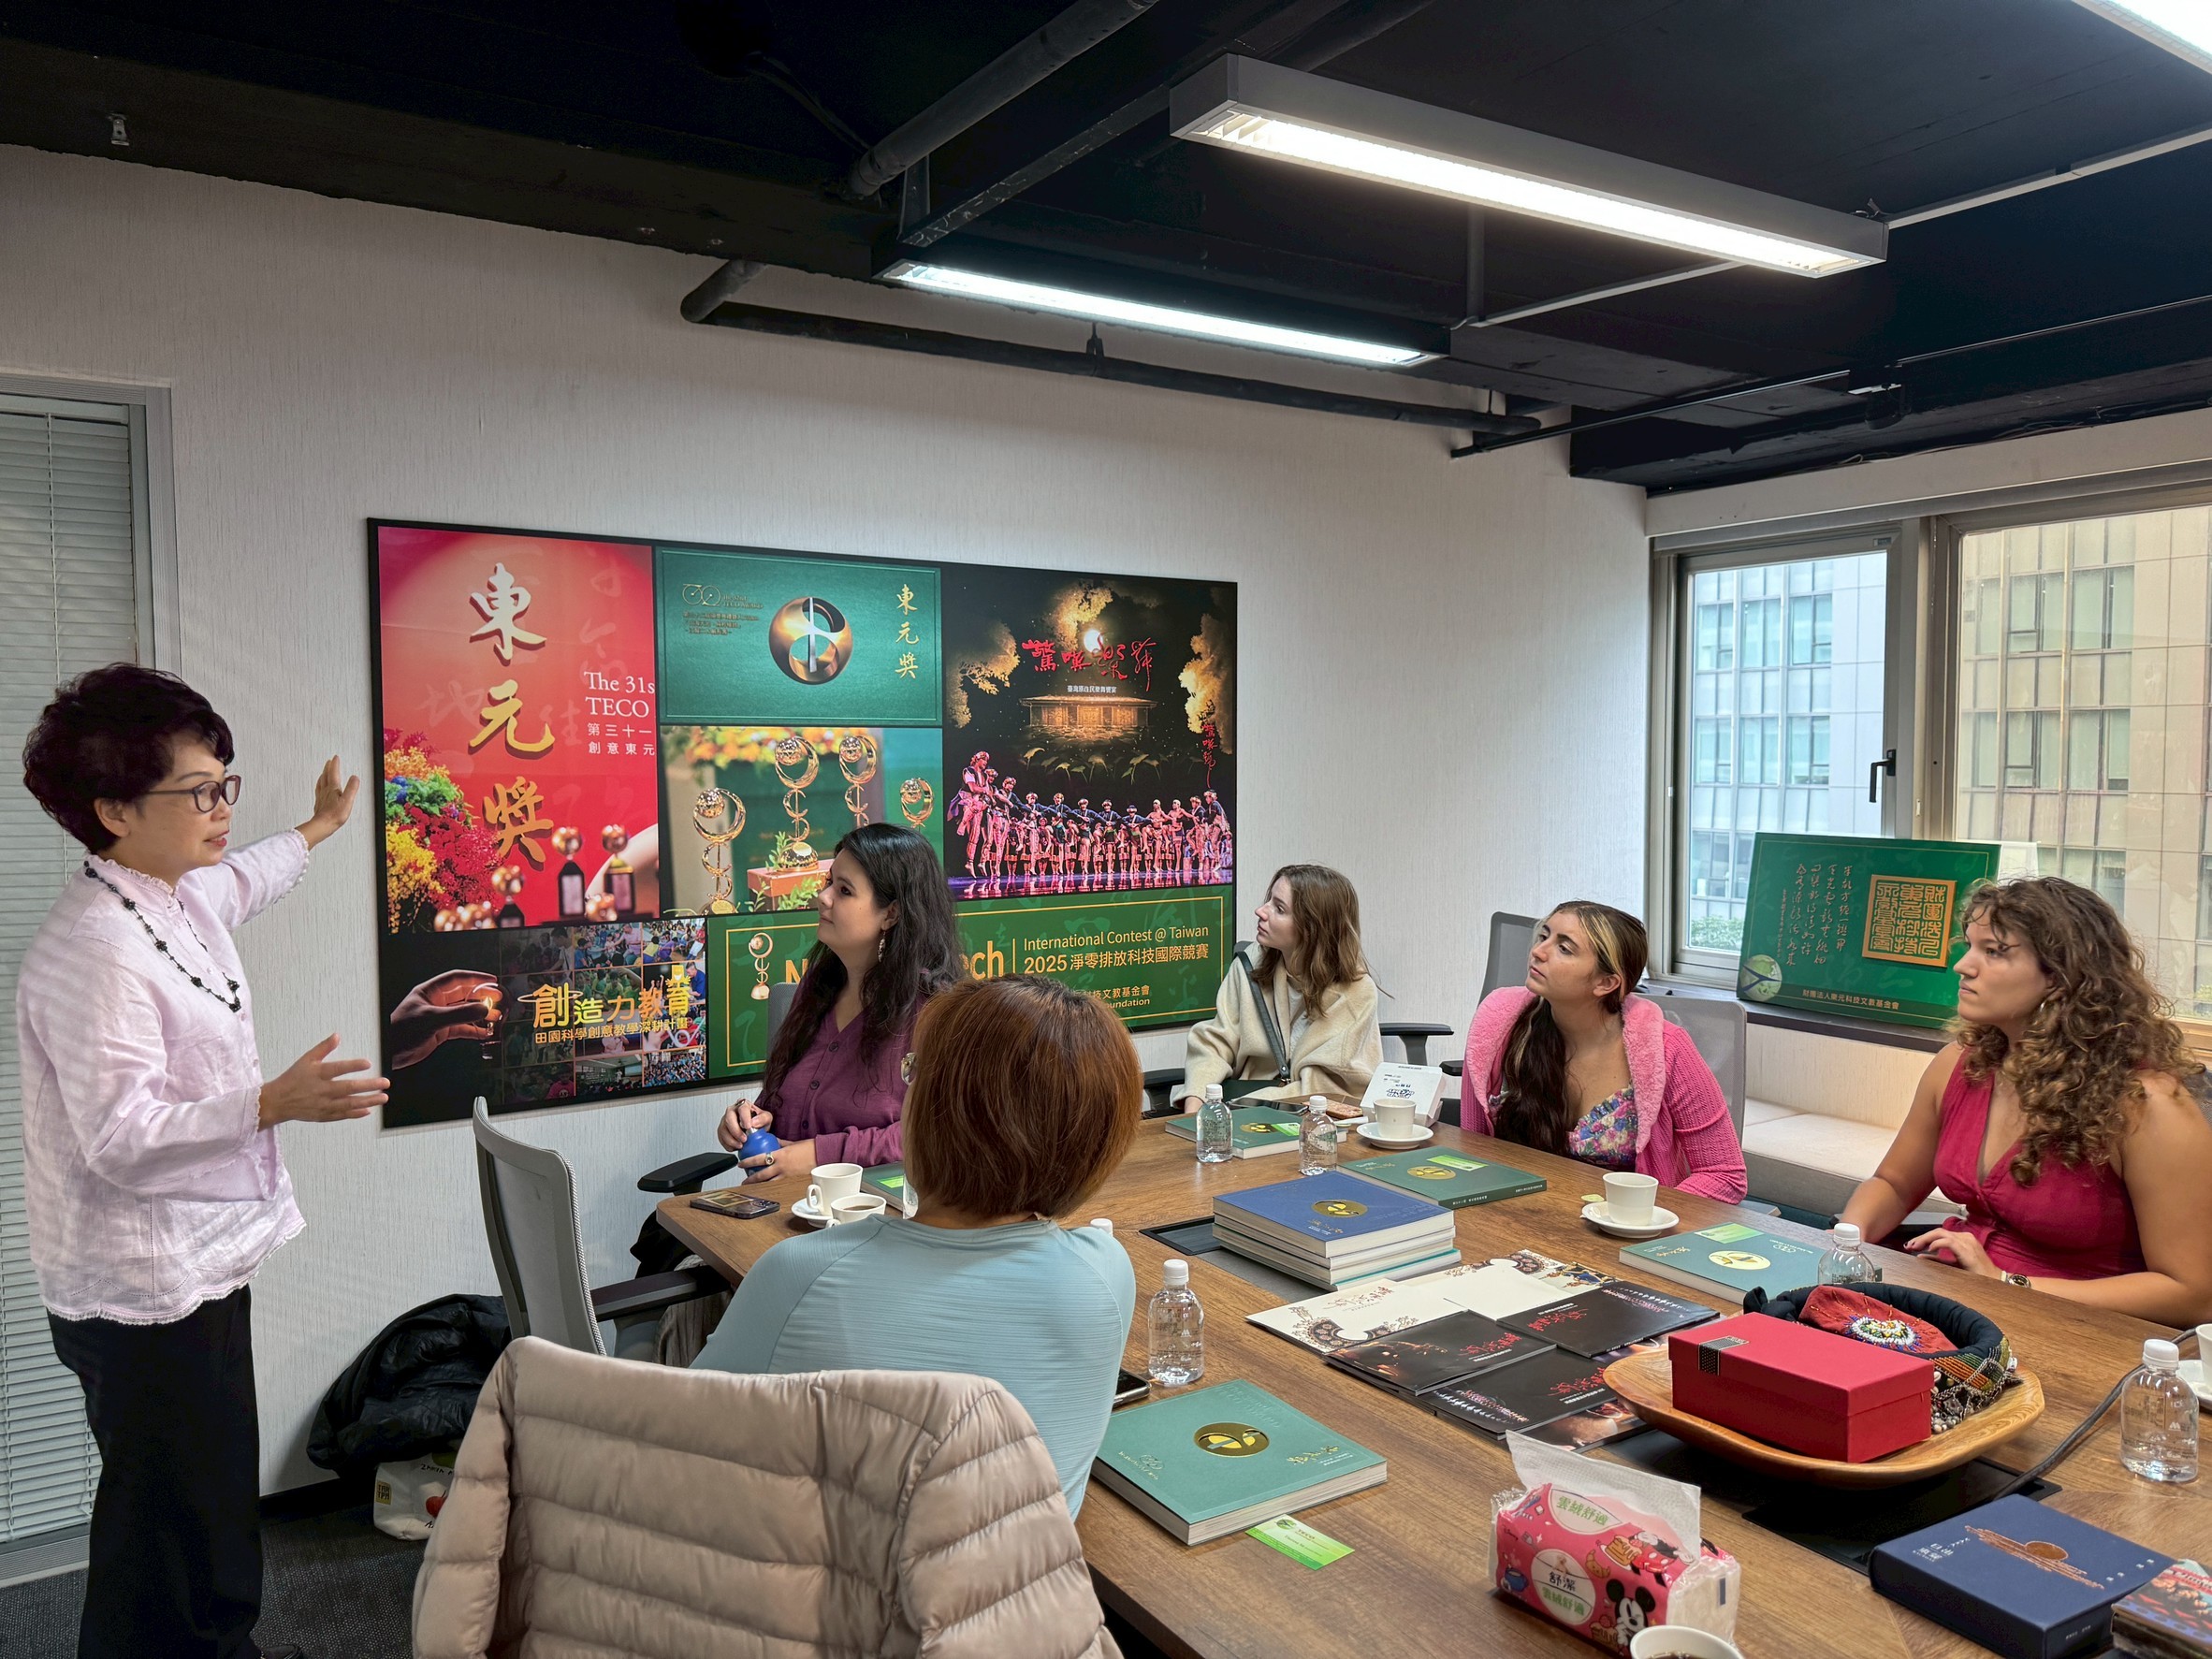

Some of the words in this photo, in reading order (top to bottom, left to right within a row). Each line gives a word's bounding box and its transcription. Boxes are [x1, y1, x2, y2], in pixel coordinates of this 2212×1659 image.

[895, 584, 920, 679] 東元獎
[584, 672, 619, 691] The
[625, 676, 655, 693] 31s
[469, 562, 555, 866] 東元獎
[585, 697, 649, 718] TECO
[588, 722, 652, 738] 第三十一
[589, 741, 655, 756] 創意東元
[1024, 930, 1104, 951] International
[1107, 928, 1152, 944] Contest
[1155, 927, 1167, 942] @
[1169, 925, 1209, 939] Taiwan
[1024, 954, 1068, 974] 2025
[1070, 943, 1209, 971] 淨零排放科技國際競賽
[533, 965, 691, 1028] 創造力教育
[535, 1017, 689, 1044] 田園科學創意教學深耕計畫
